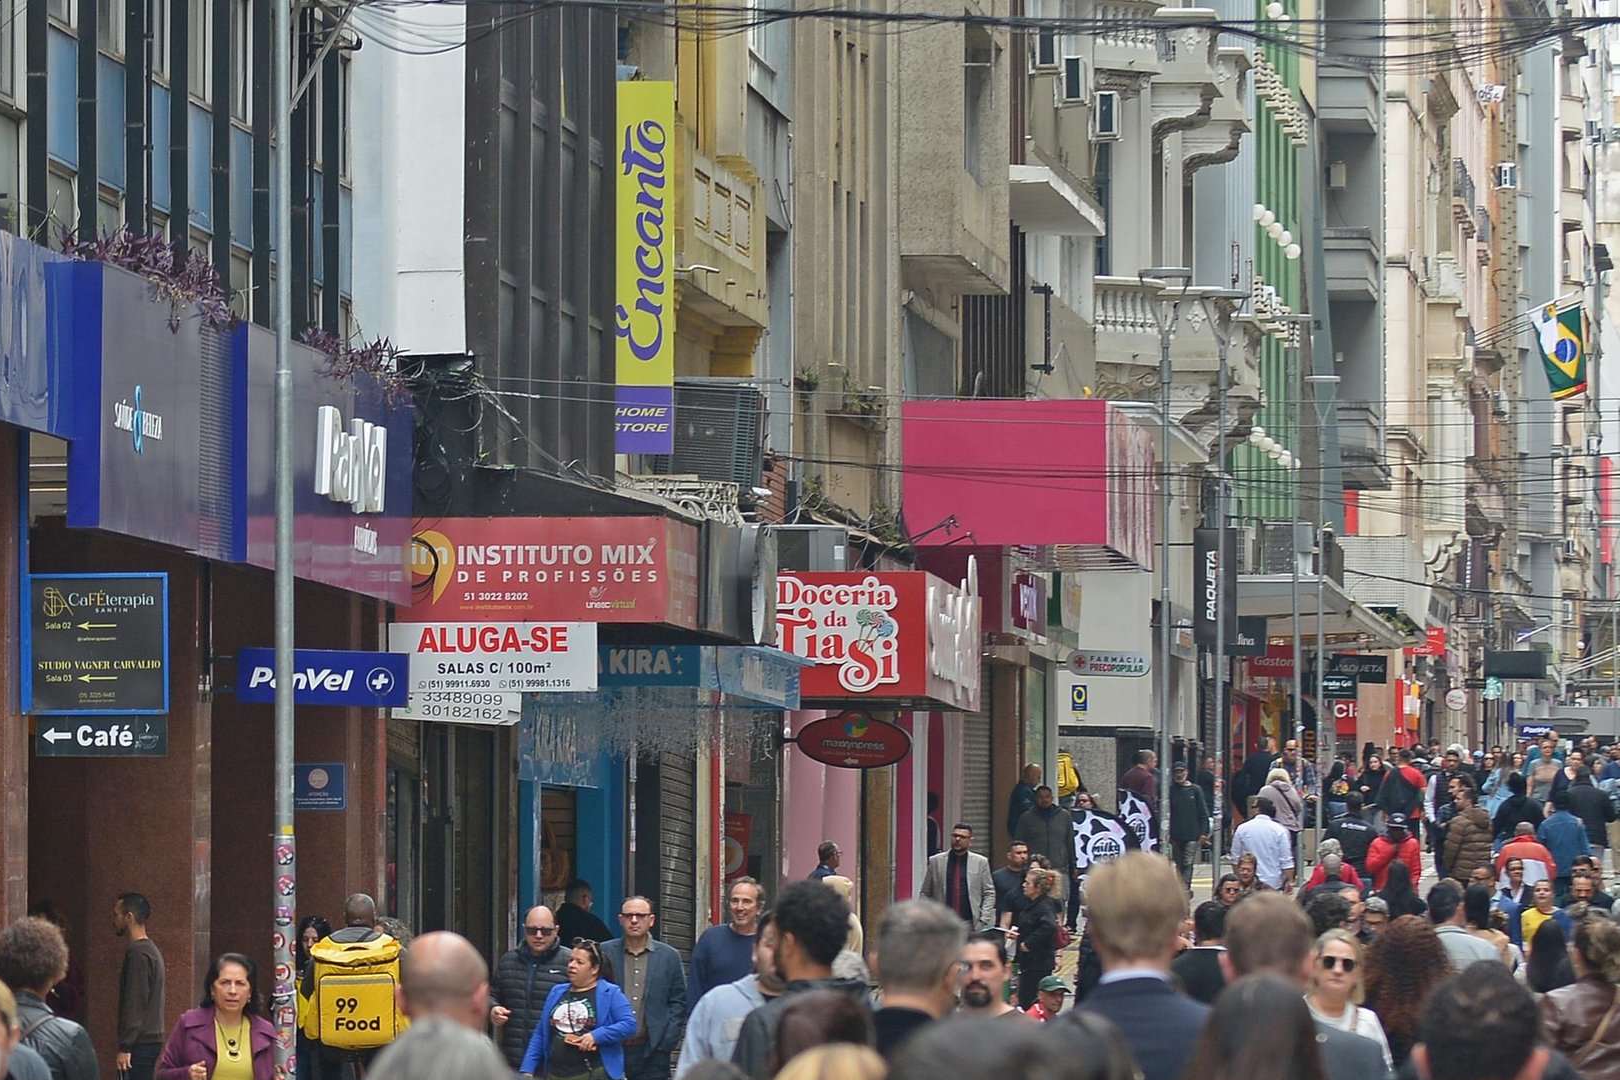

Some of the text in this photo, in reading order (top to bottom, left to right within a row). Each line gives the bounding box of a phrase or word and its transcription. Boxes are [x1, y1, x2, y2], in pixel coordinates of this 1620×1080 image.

[615, 119, 667, 362] Encanto
[616, 406, 669, 421] HOME
[457, 544, 655, 566] INSTITUTO MIX
[457, 565, 659, 583] DE PROFISSÕES
[464, 592, 529, 601] 51 3022 8202
[778, 575, 892, 607] Doceria
[823, 610, 848, 628] da
[417, 626, 569, 653] ALUGA-SE
[776, 607, 846, 661] Tia
[38, 661, 72, 670] STUDIO
[74, 661, 111, 670] VAGNER
[437, 662, 485, 675] SALAS
[489, 661, 504, 675] C/
[609, 649, 672, 675] KIRA
[843, 638, 894, 687] Si
[428, 680, 444, 690] (51)
[508, 680, 524, 690] (51)
[421, 705, 502, 720] 30182162
[76, 725, 133, 747] Café
[335, 997, 358, 1014] 99
[335, 1016, 381, 1031] Food
